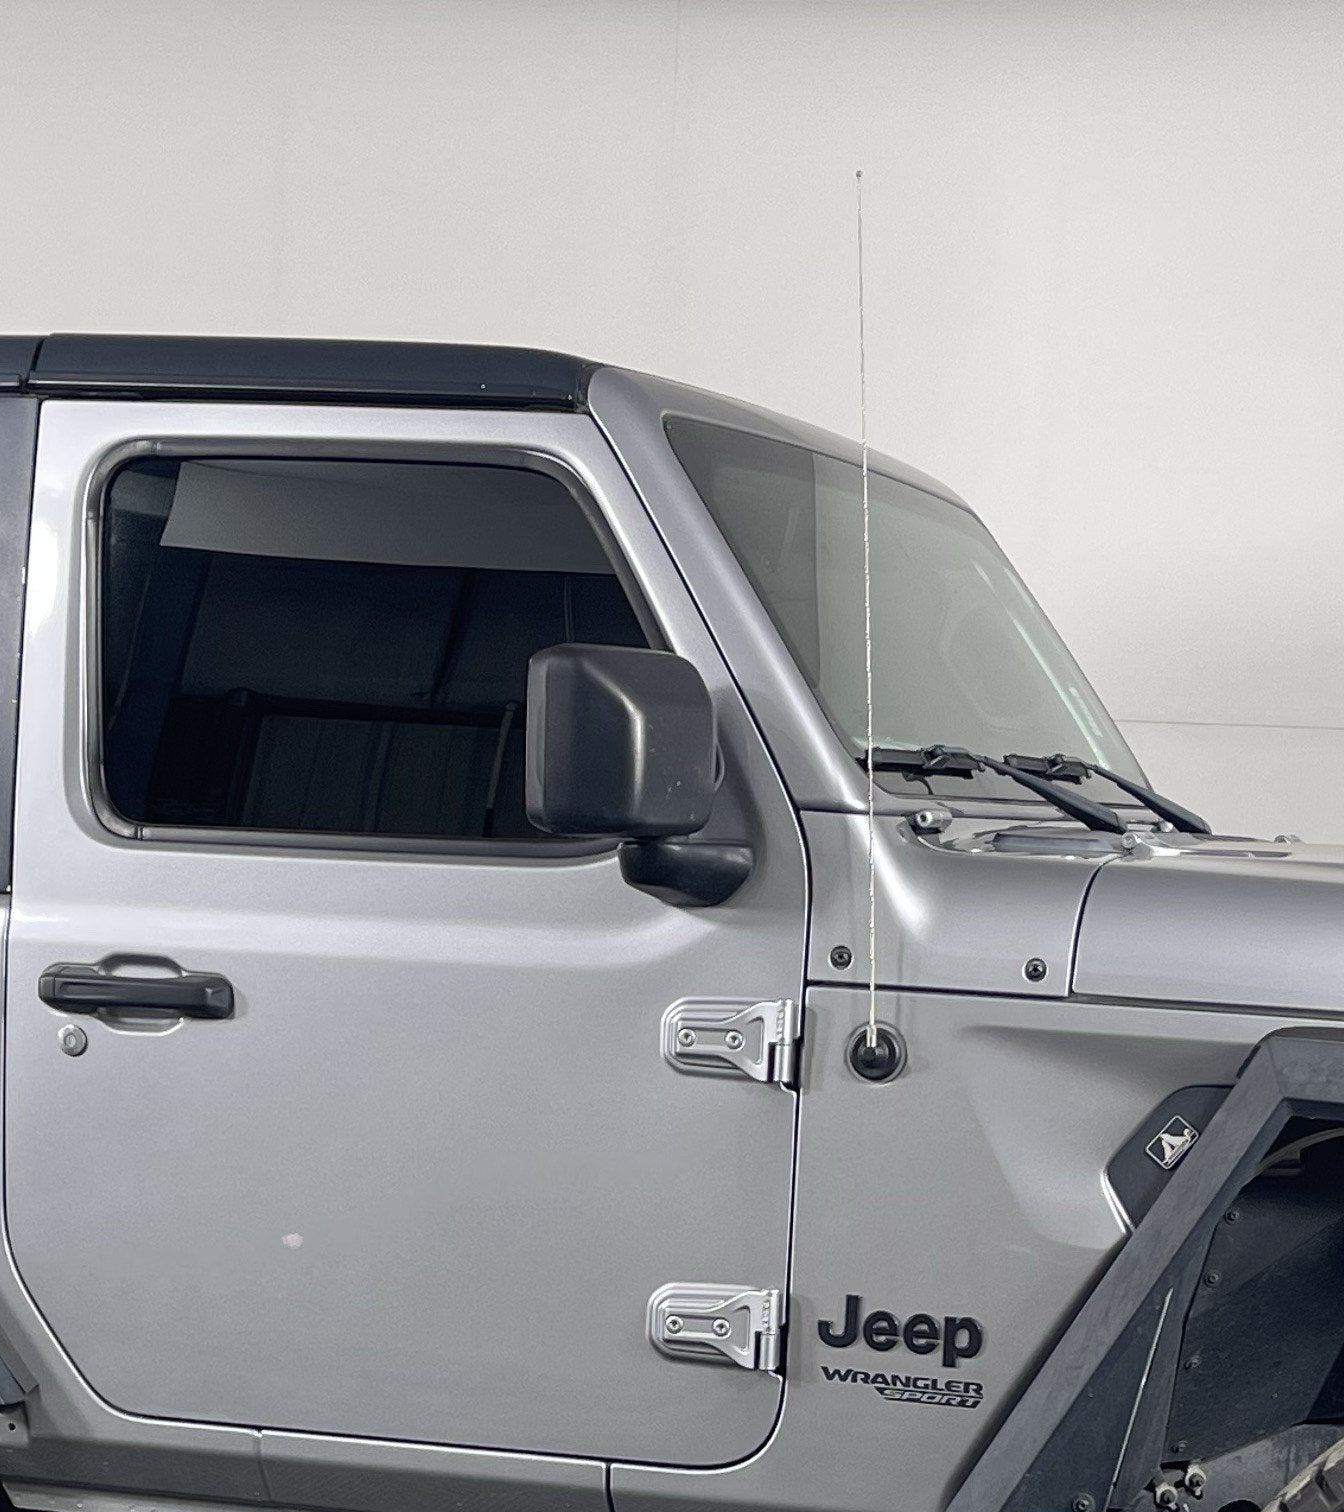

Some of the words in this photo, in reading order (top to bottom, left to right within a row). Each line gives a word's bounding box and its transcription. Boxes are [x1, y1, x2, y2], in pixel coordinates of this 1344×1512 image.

[817, 1294, 984, 1368] Jeep
[820, 1366, 983, 1396] WRANGLER
[877, 1386, 983, 1408] SPORT
